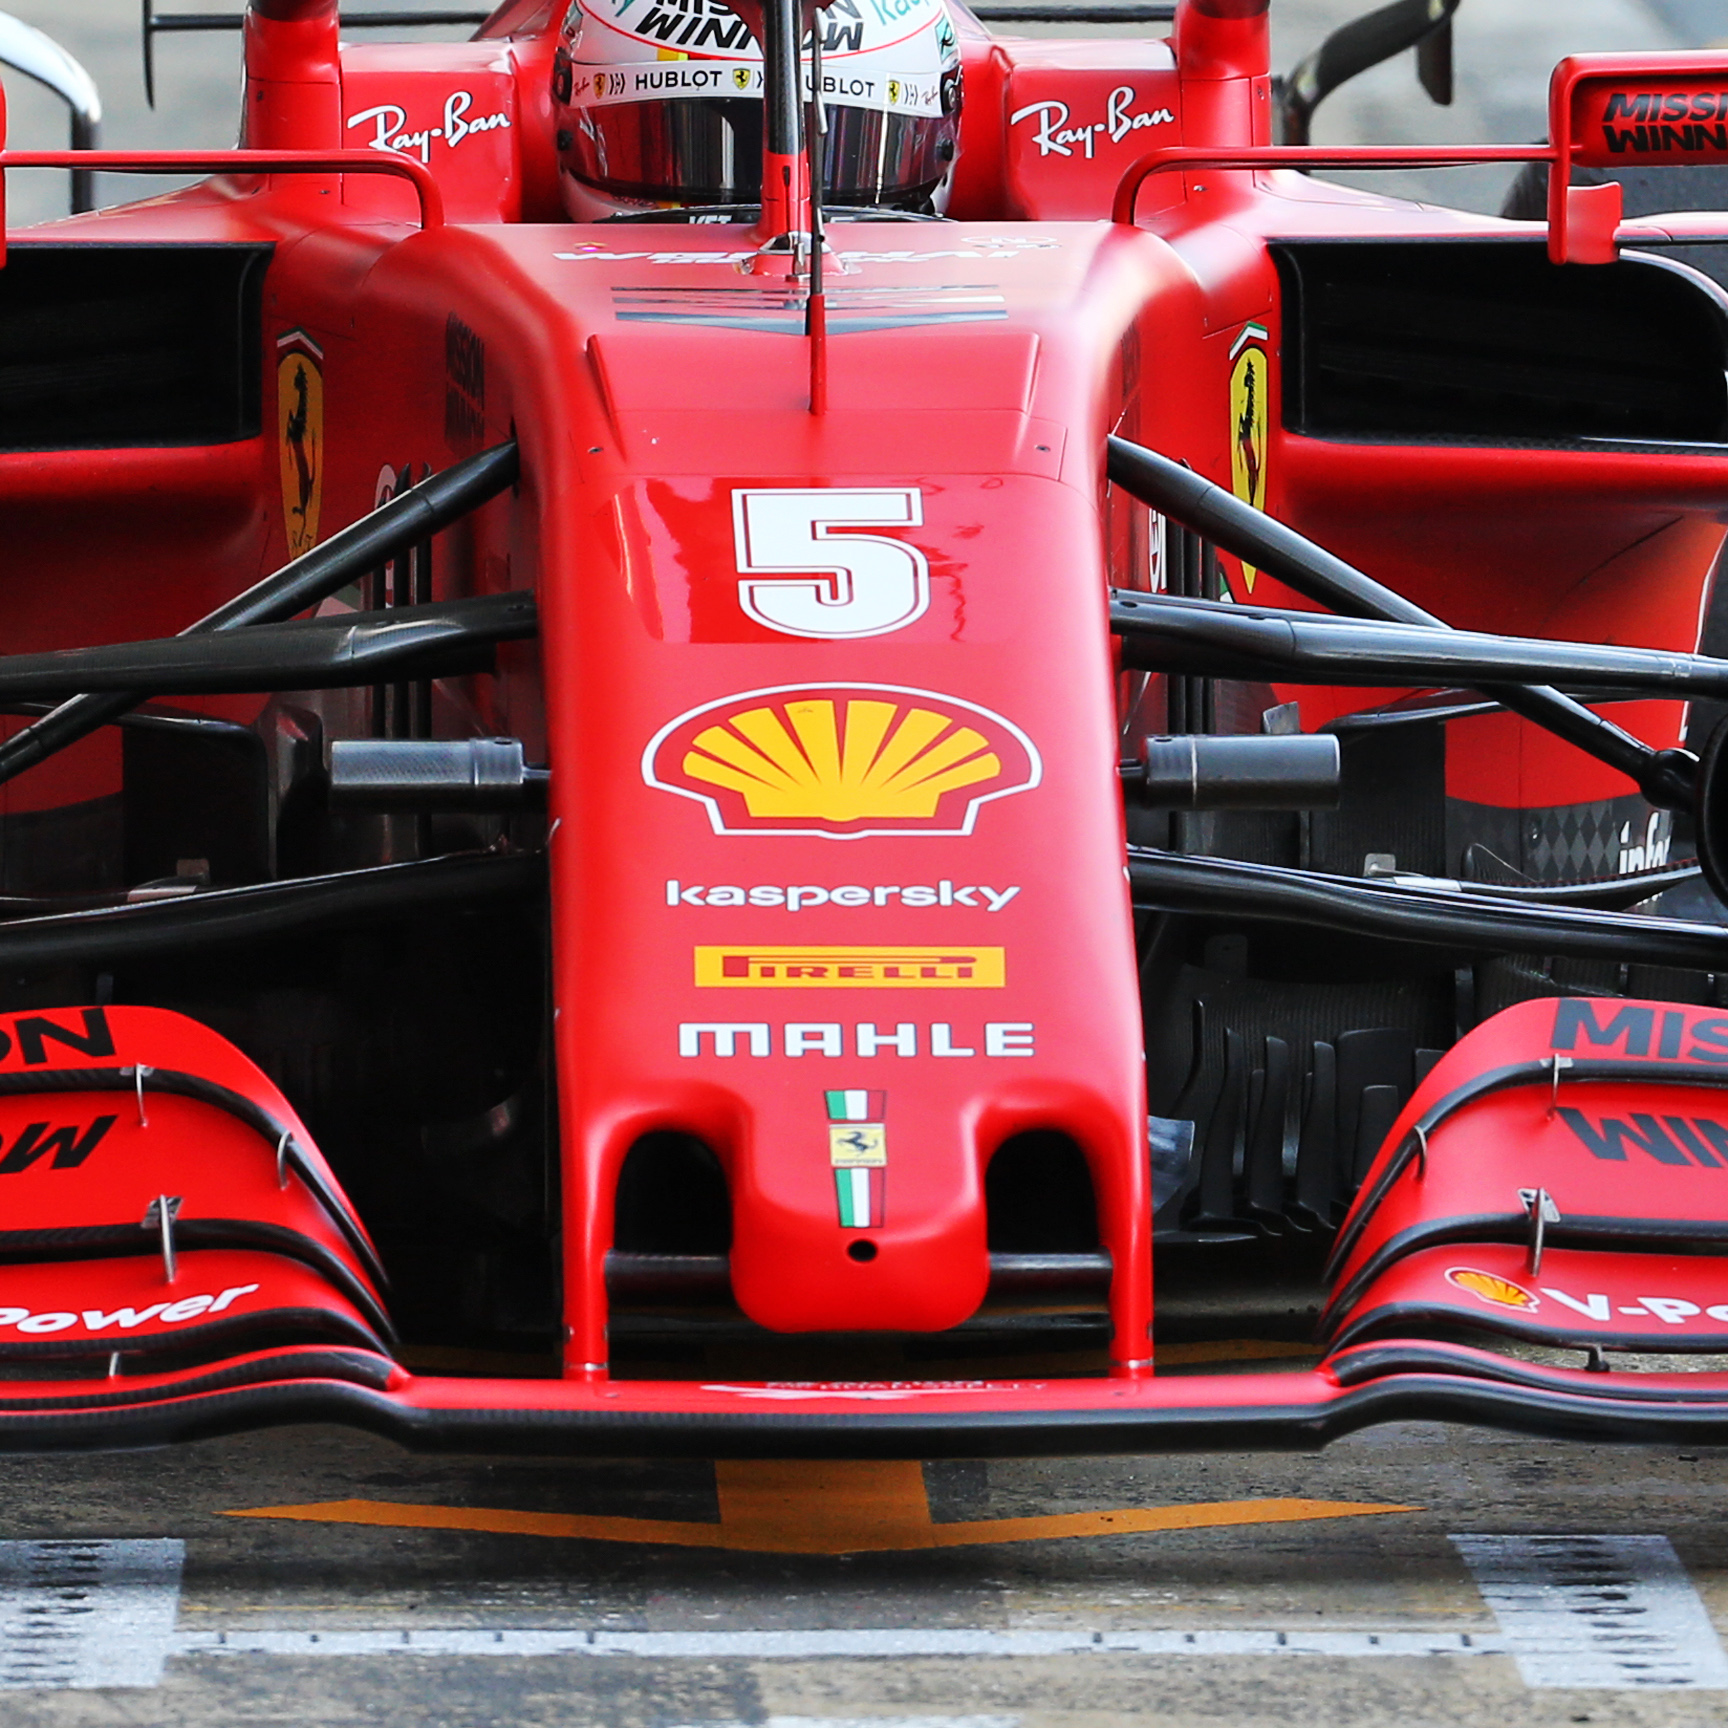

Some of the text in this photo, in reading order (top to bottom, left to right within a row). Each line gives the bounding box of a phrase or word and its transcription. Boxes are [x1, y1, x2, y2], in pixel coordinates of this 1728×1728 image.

[635, 70, 723, 91] HUBLOT
[347, 91, 512, 164] Ray-Ban
[1010, 86, 1175, 159] Ray-Ban
[730, 488, 932, 640] 5
[667, 880, 1020, 912] kaspersky
[723, 955, 977, 978] PIRELLI
[679, 1022, 1035, 1058] MAHLE
